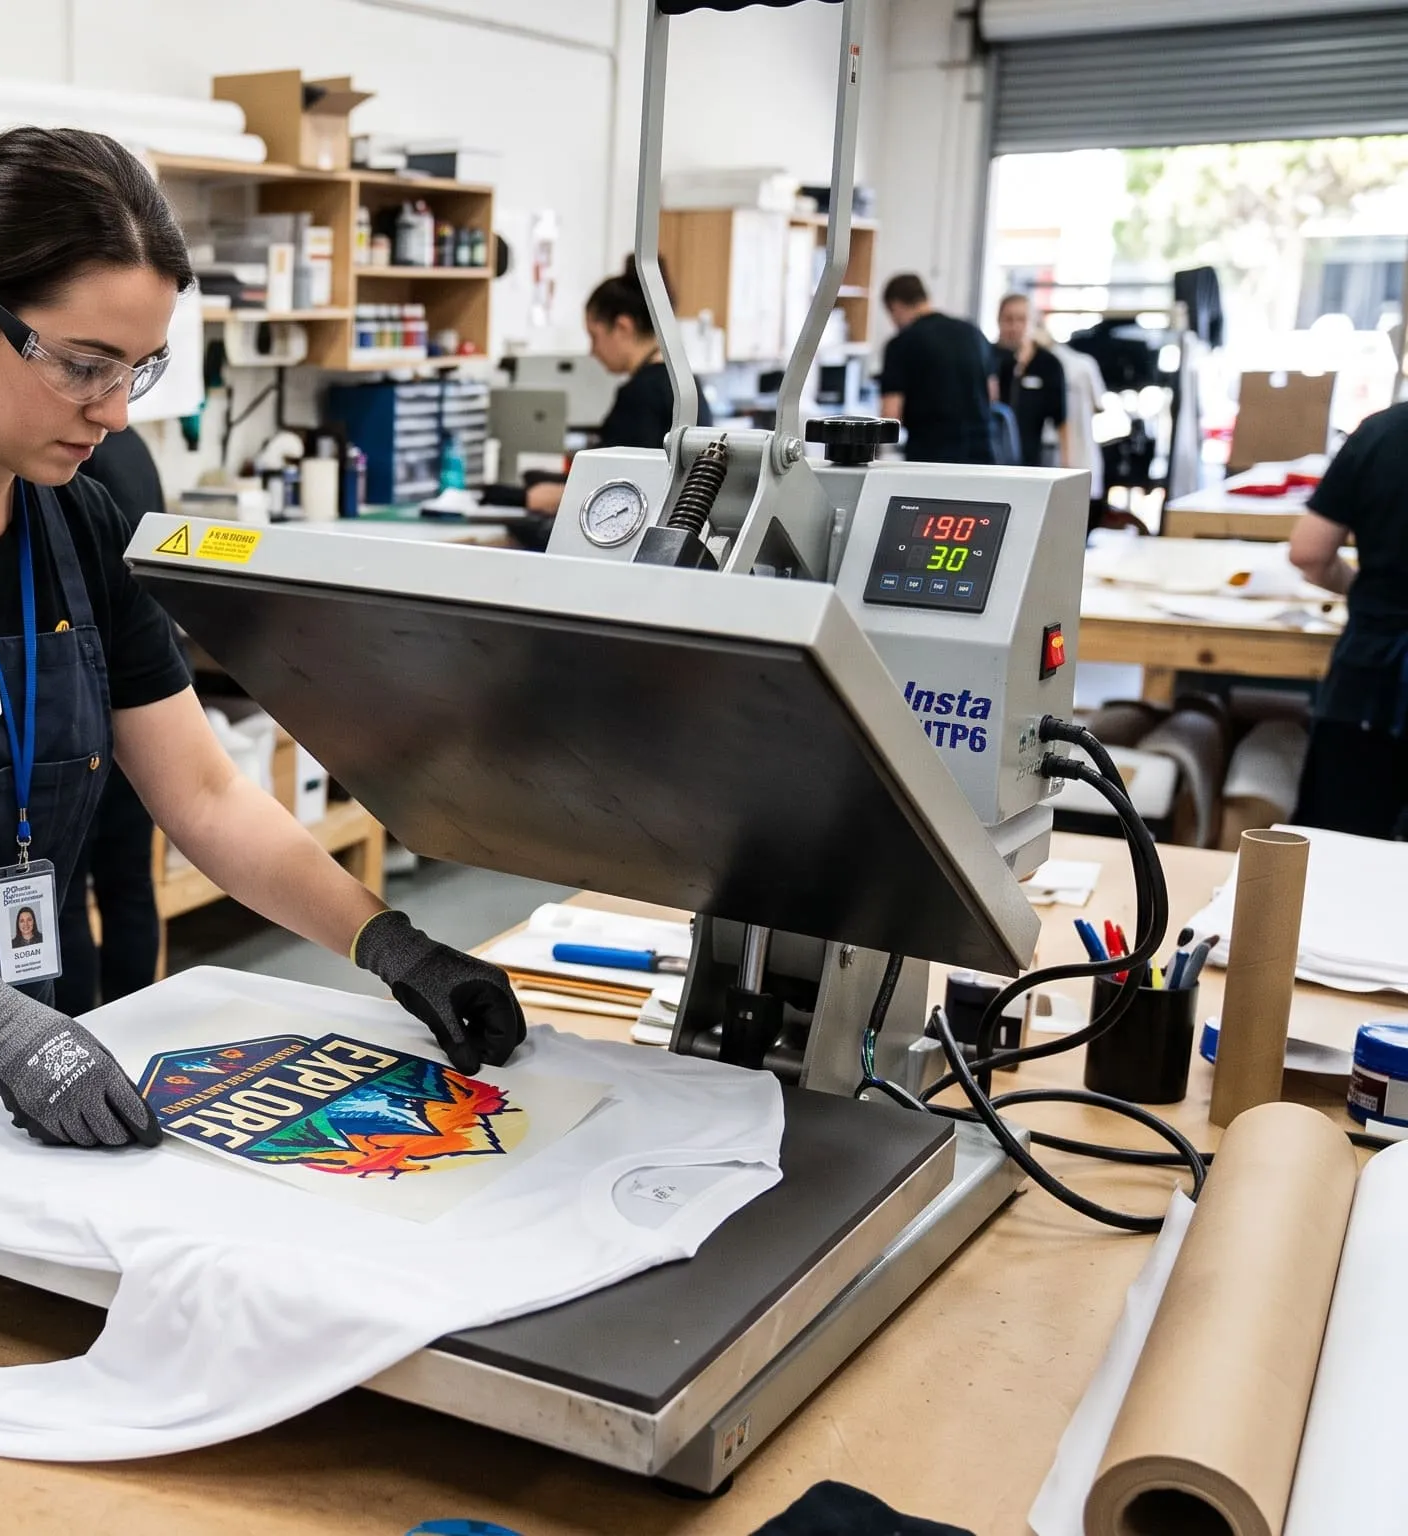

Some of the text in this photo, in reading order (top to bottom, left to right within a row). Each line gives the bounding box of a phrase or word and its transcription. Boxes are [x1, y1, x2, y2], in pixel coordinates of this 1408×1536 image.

[923, 515, 976, 541] 190
[926, 545, 969, 572] 30
[904, 681, 992, 720] Insta
[167, 1038, 400, 1150] EXPLORE
